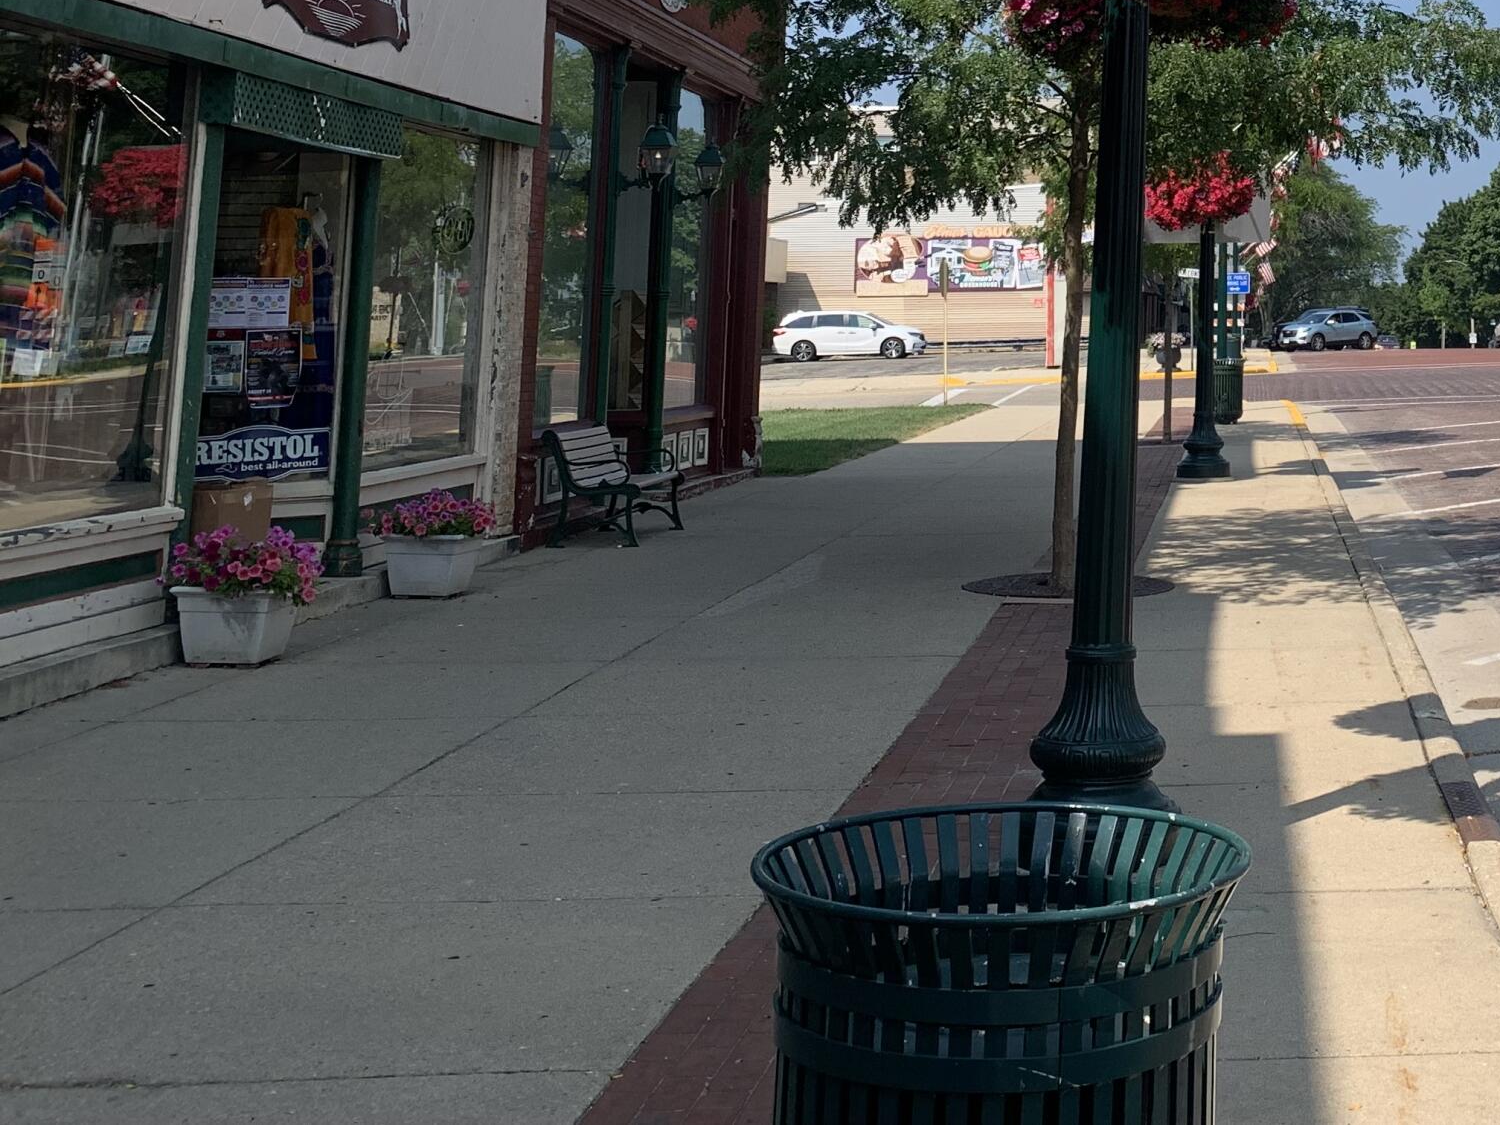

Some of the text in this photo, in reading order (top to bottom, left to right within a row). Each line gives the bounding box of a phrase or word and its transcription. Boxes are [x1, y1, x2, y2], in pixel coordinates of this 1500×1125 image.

[195, 434, 319, 466] RESISTOL
[240, 458, 319, 472] best all-around
